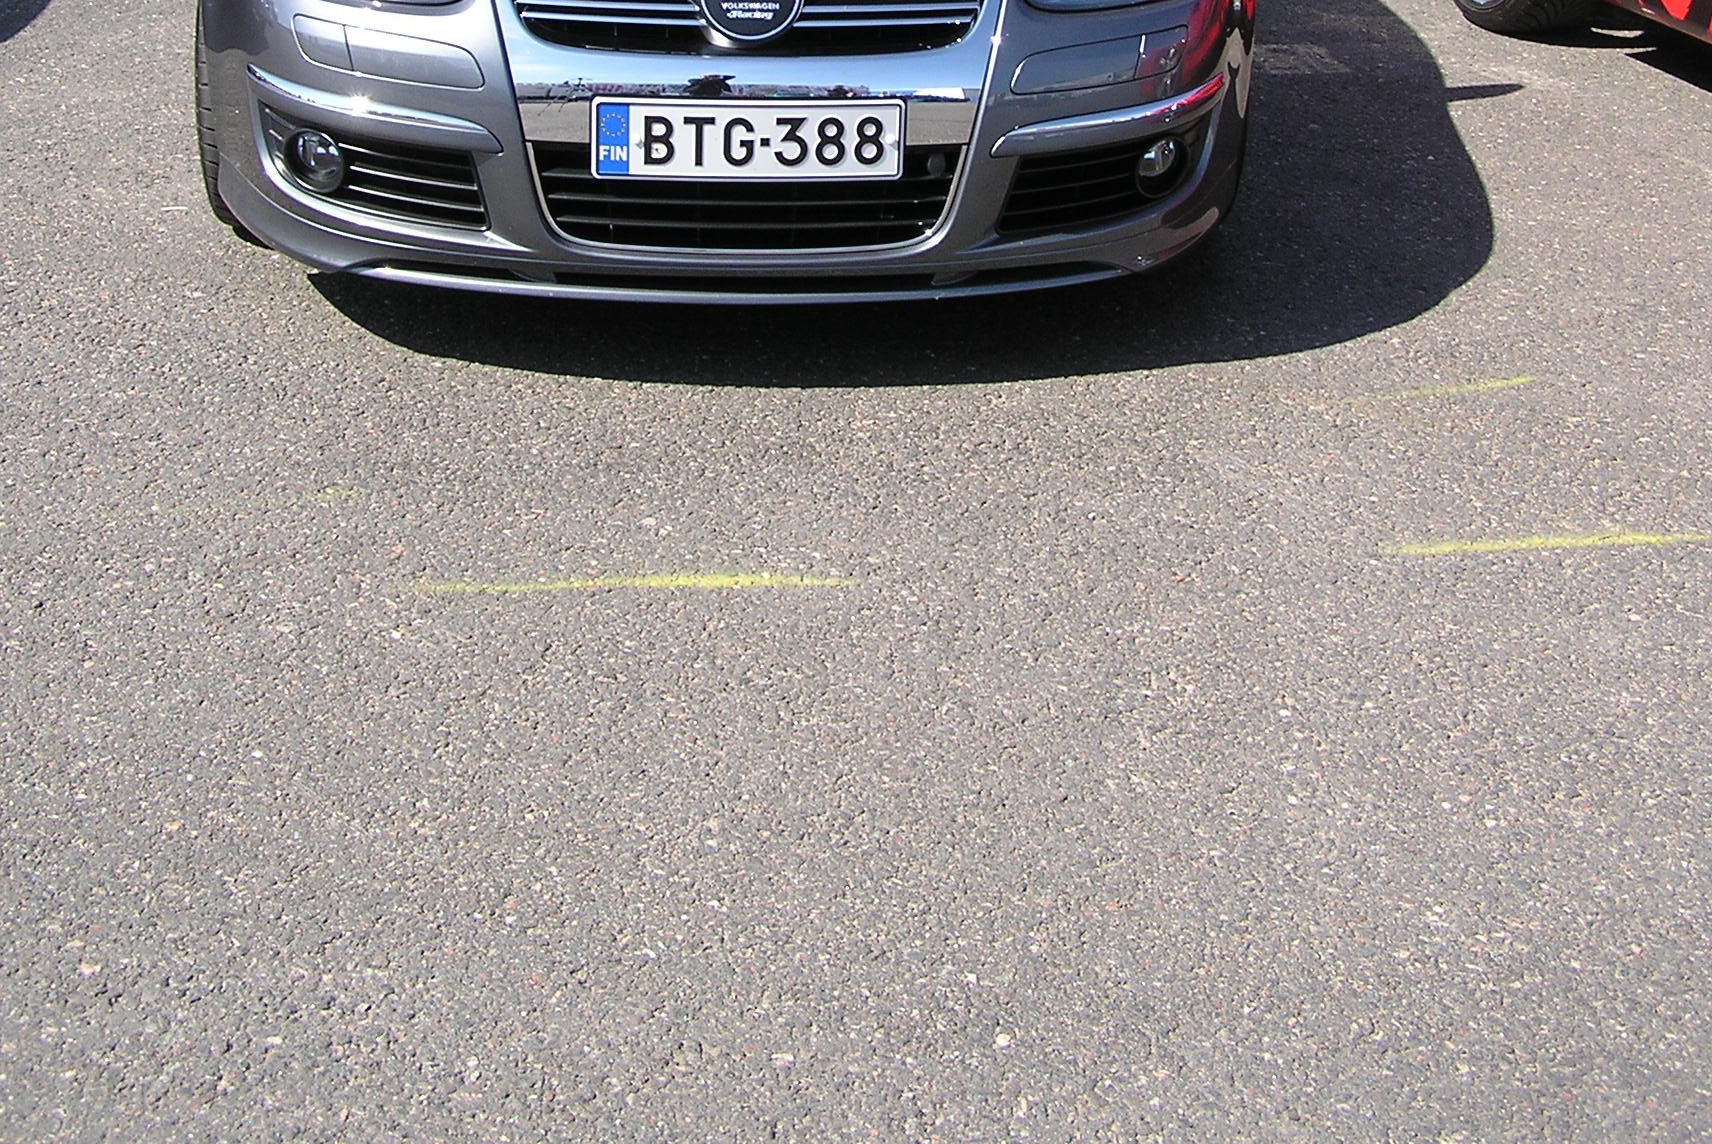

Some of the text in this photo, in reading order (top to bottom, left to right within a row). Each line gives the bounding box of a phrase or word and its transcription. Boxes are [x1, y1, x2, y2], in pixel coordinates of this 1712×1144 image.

[721, 2, 780, 10] VOLKSWAGEN
[643, 115, 884, 167] BTG-388
[599, 145, 628, 161] FIN
